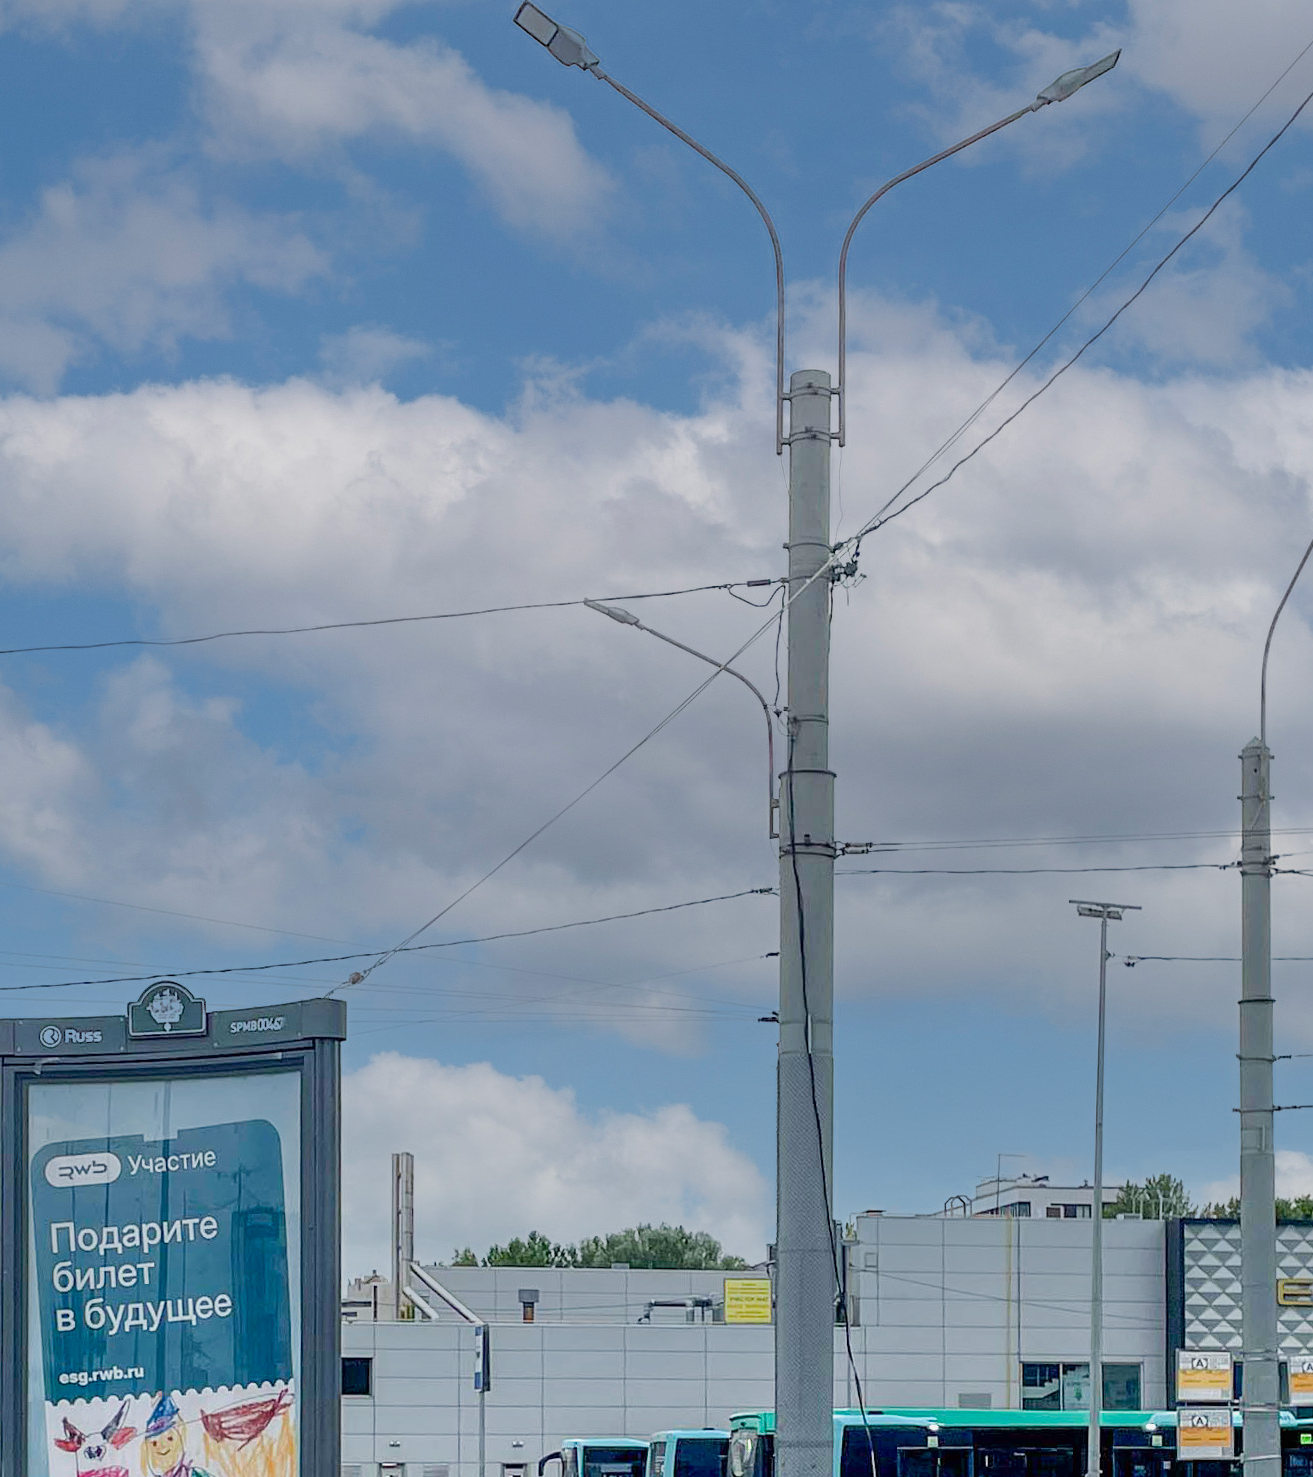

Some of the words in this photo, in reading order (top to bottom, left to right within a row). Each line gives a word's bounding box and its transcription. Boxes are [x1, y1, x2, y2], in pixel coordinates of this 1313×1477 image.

[65, 1028, 103, 1044] Russ
[128, 1150, 217, 1175] Участие
[50, 1215, 219, 1256] Подарите
[52, 1261, 155, 1293] билет
[56, 1308, 76, 1332] в
[85, 1293, 233, 1335] будущее
[58, 1365, 145, 1387] esg.rwb.ru
